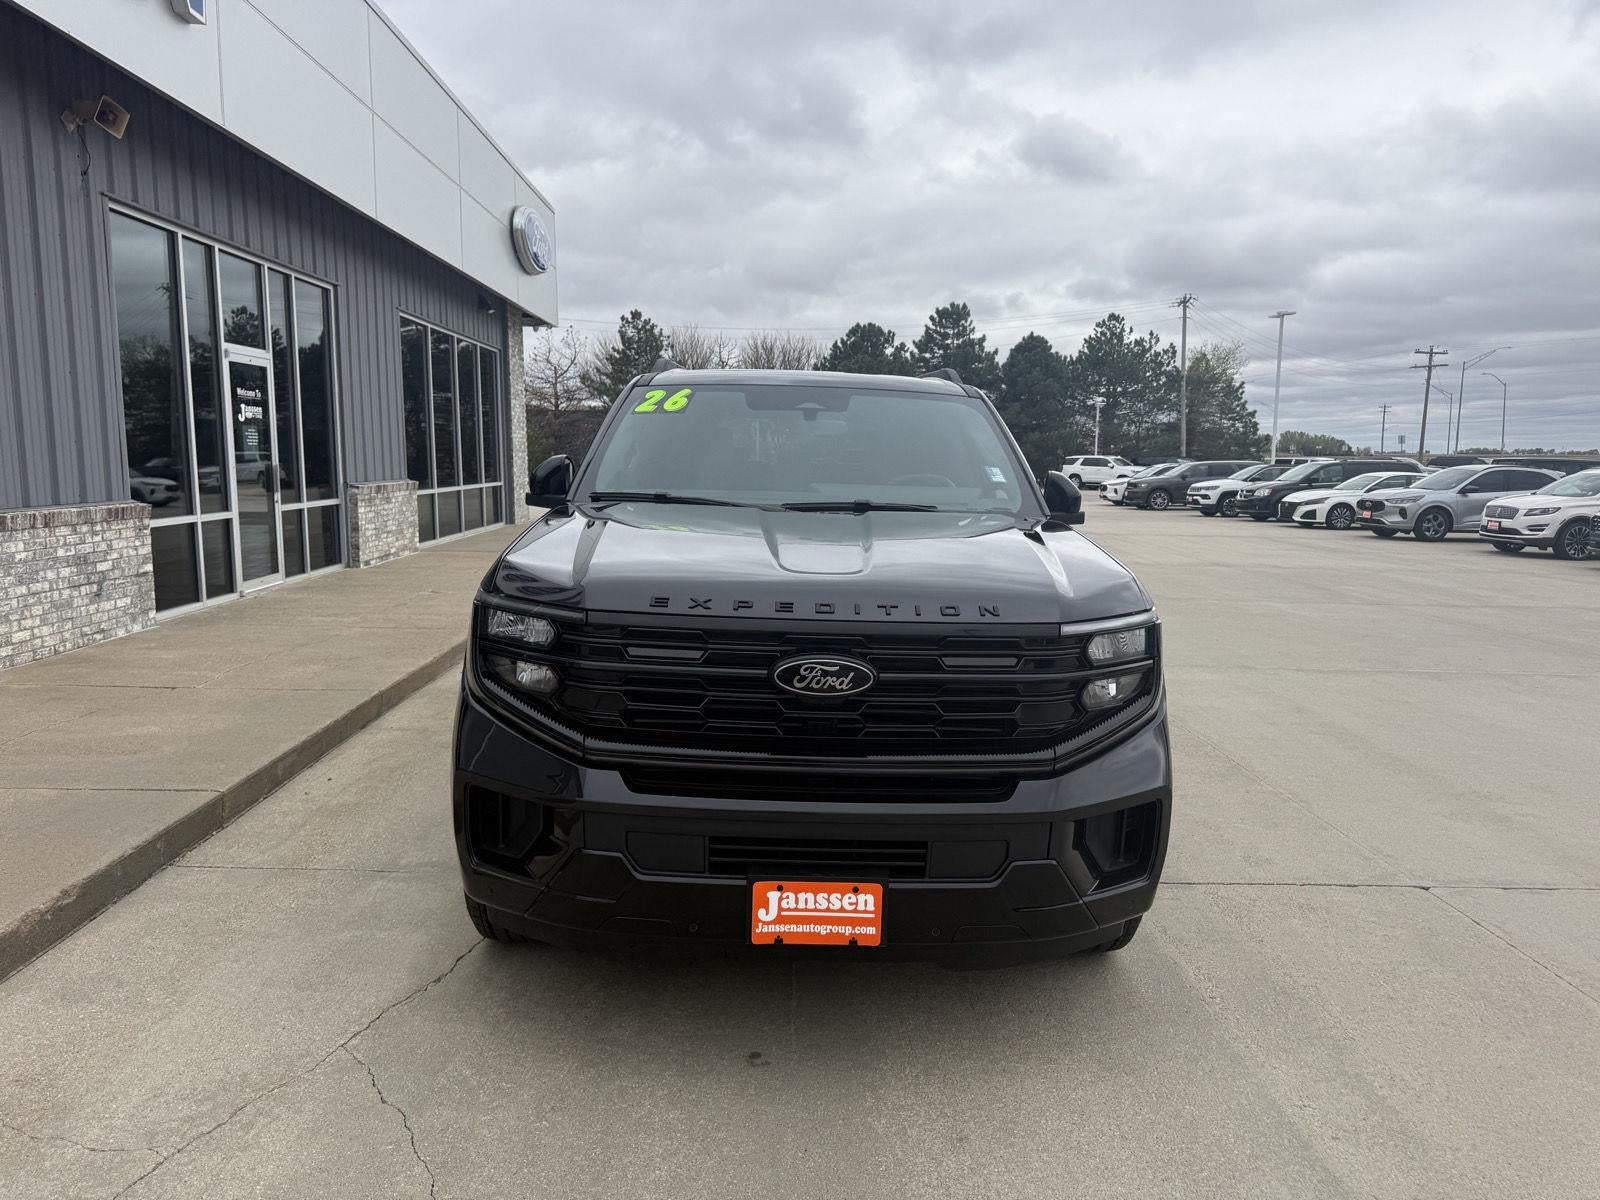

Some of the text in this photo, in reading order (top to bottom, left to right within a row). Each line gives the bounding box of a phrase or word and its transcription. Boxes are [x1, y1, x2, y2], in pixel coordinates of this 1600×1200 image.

[634, 388, 693, 412] 26
[649, 596, 1000, 617] EXPEDITION
[793, 664, 855, 690] Ford
[757, 891, 875, 922] Janssen
[756, 922, 876, 935] Janssenautogroup.com
